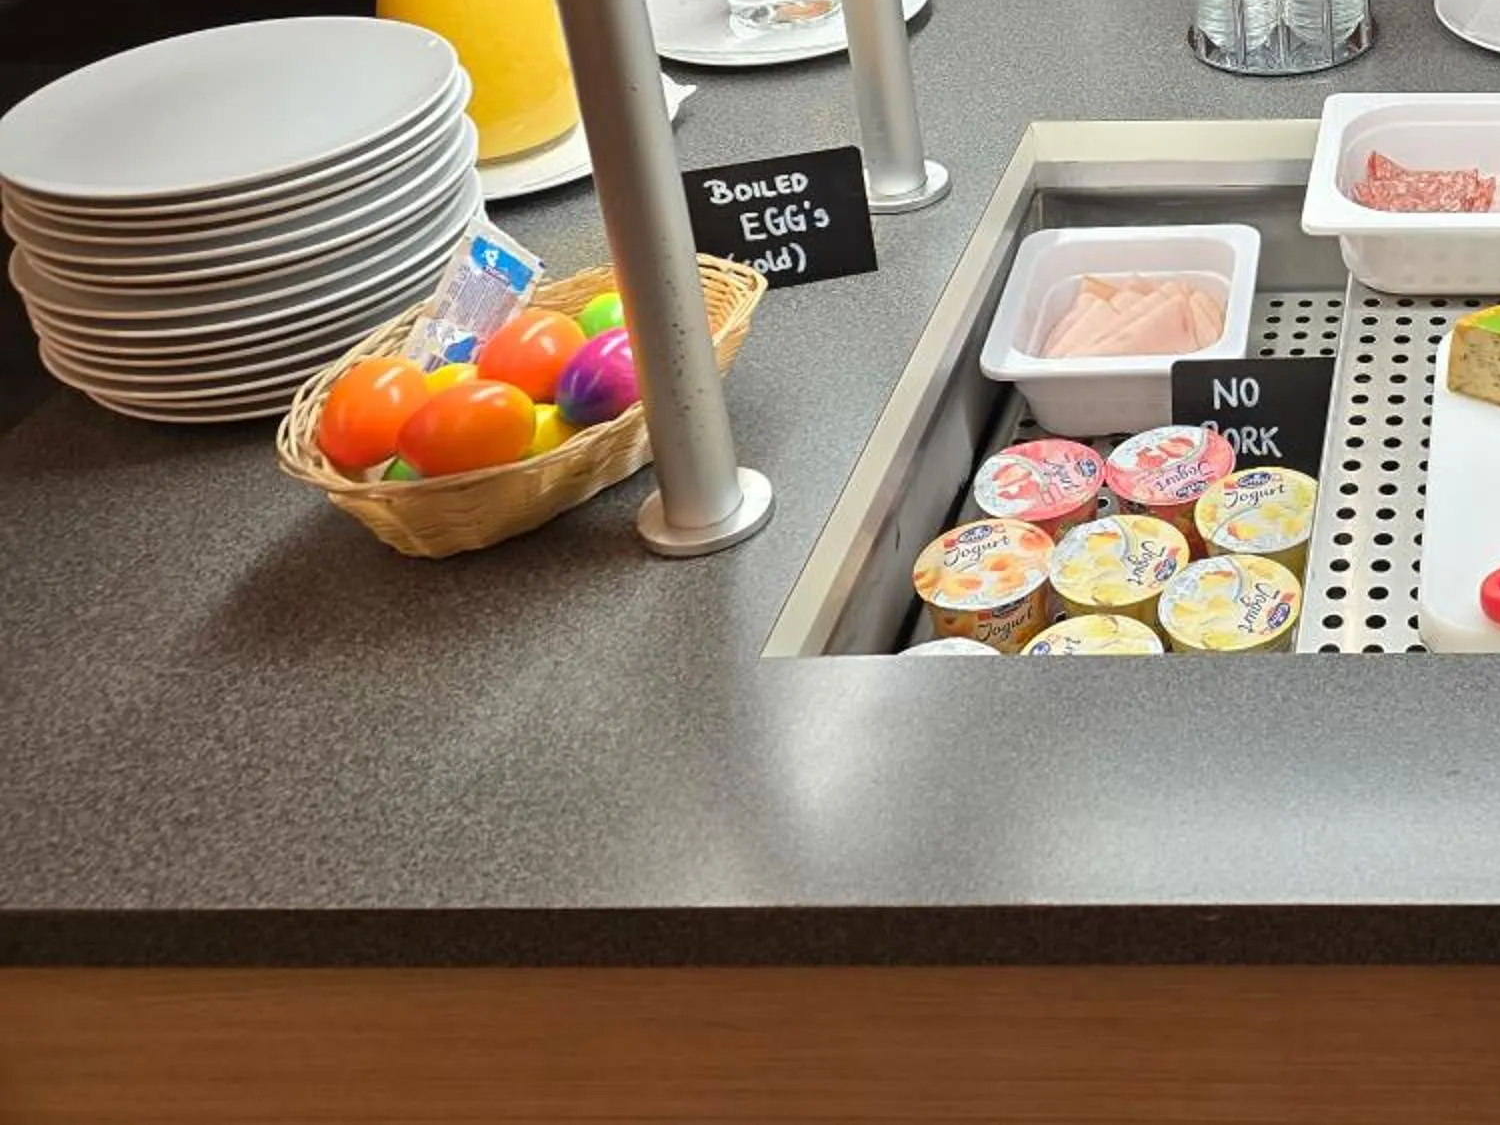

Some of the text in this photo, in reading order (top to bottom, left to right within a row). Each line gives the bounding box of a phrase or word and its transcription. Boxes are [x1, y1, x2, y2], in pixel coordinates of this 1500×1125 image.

[703, 172, 809, 205] BOILED
[739, 201, 831, 242] EGG's
[1213, 377, 1260, 410] NO
[1223, 484, 1285, 509] Jogurt
[943, 534, 1010, 567] Jogurt
[976, 606, 1033, 642] Jogurt
[1237, 582, 1281, 634] Jogurt
